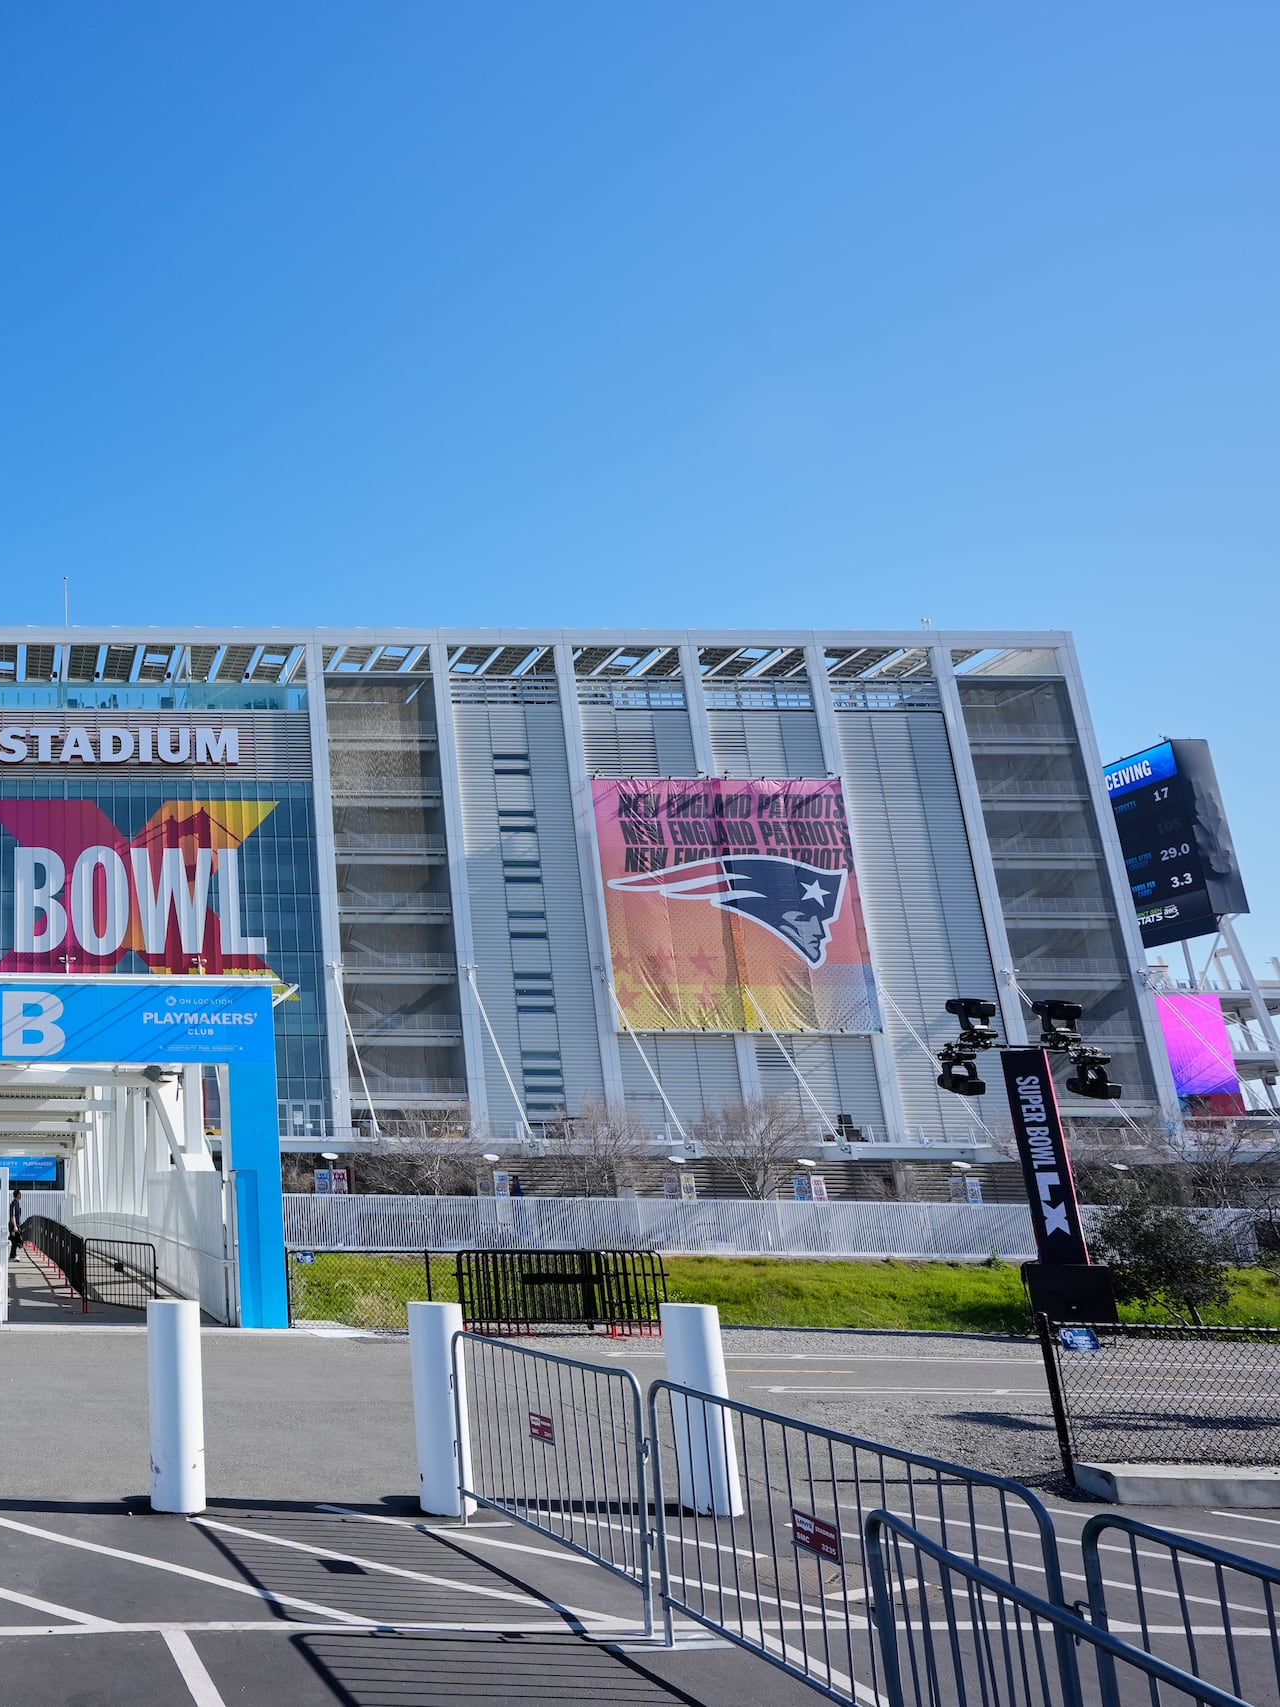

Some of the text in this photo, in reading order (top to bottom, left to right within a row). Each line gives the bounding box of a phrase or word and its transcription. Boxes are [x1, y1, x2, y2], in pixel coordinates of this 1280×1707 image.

[1153, 787, 1170, 802] 17
[618, 794, 845, 819] NEW ENGLAND PATRIOTS
[619, 820, 851, 847] NEW ENGLAND PATRIOTS
[625, 847, 669, 873] NEW
[1160, 843, 1191, 862] 29.0
[1170, 872, 1193, 889] 3.3
[14, 846, 268, 955] BOWL
[1136, 912, 1163, 926] STATS
[1, 990, 66, 1057] B
[142, 1011, 258, 1025] PLAYMAKERS'
[187, 1028, 214, 1036] CLUB
[1016, 1075, 1071, 1237] SUPER BOWL LX
[796, 1532, 810, 1544] SMC
[814, 1526, 836, 1540] STADIUM
